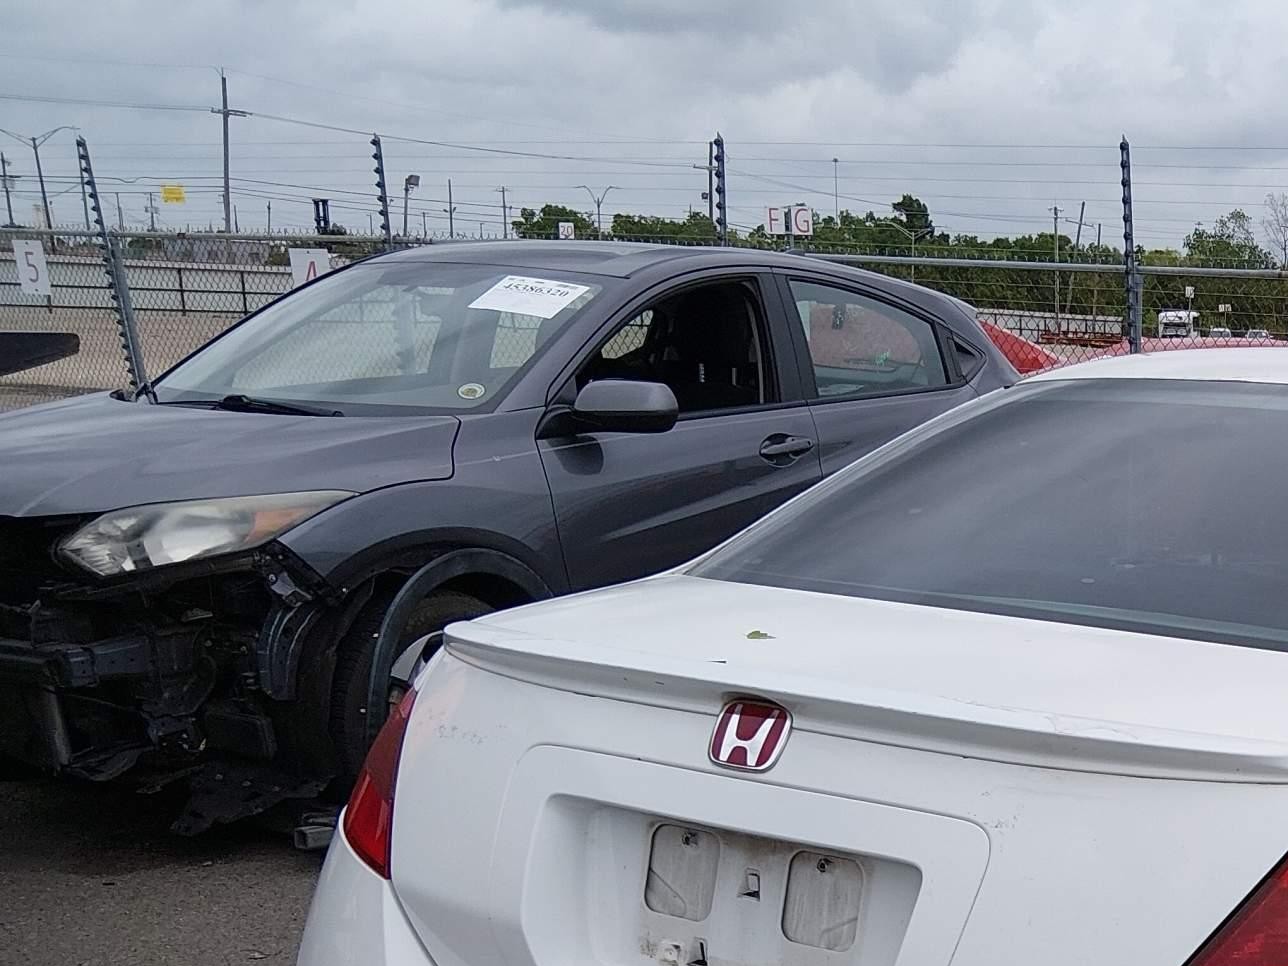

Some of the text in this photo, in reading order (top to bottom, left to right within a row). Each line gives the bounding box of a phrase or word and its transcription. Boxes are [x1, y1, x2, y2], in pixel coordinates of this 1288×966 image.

[768, 207, 779, 233] F
[794, 207, 810, 233] G
[24, 251, 39, 283] 5
